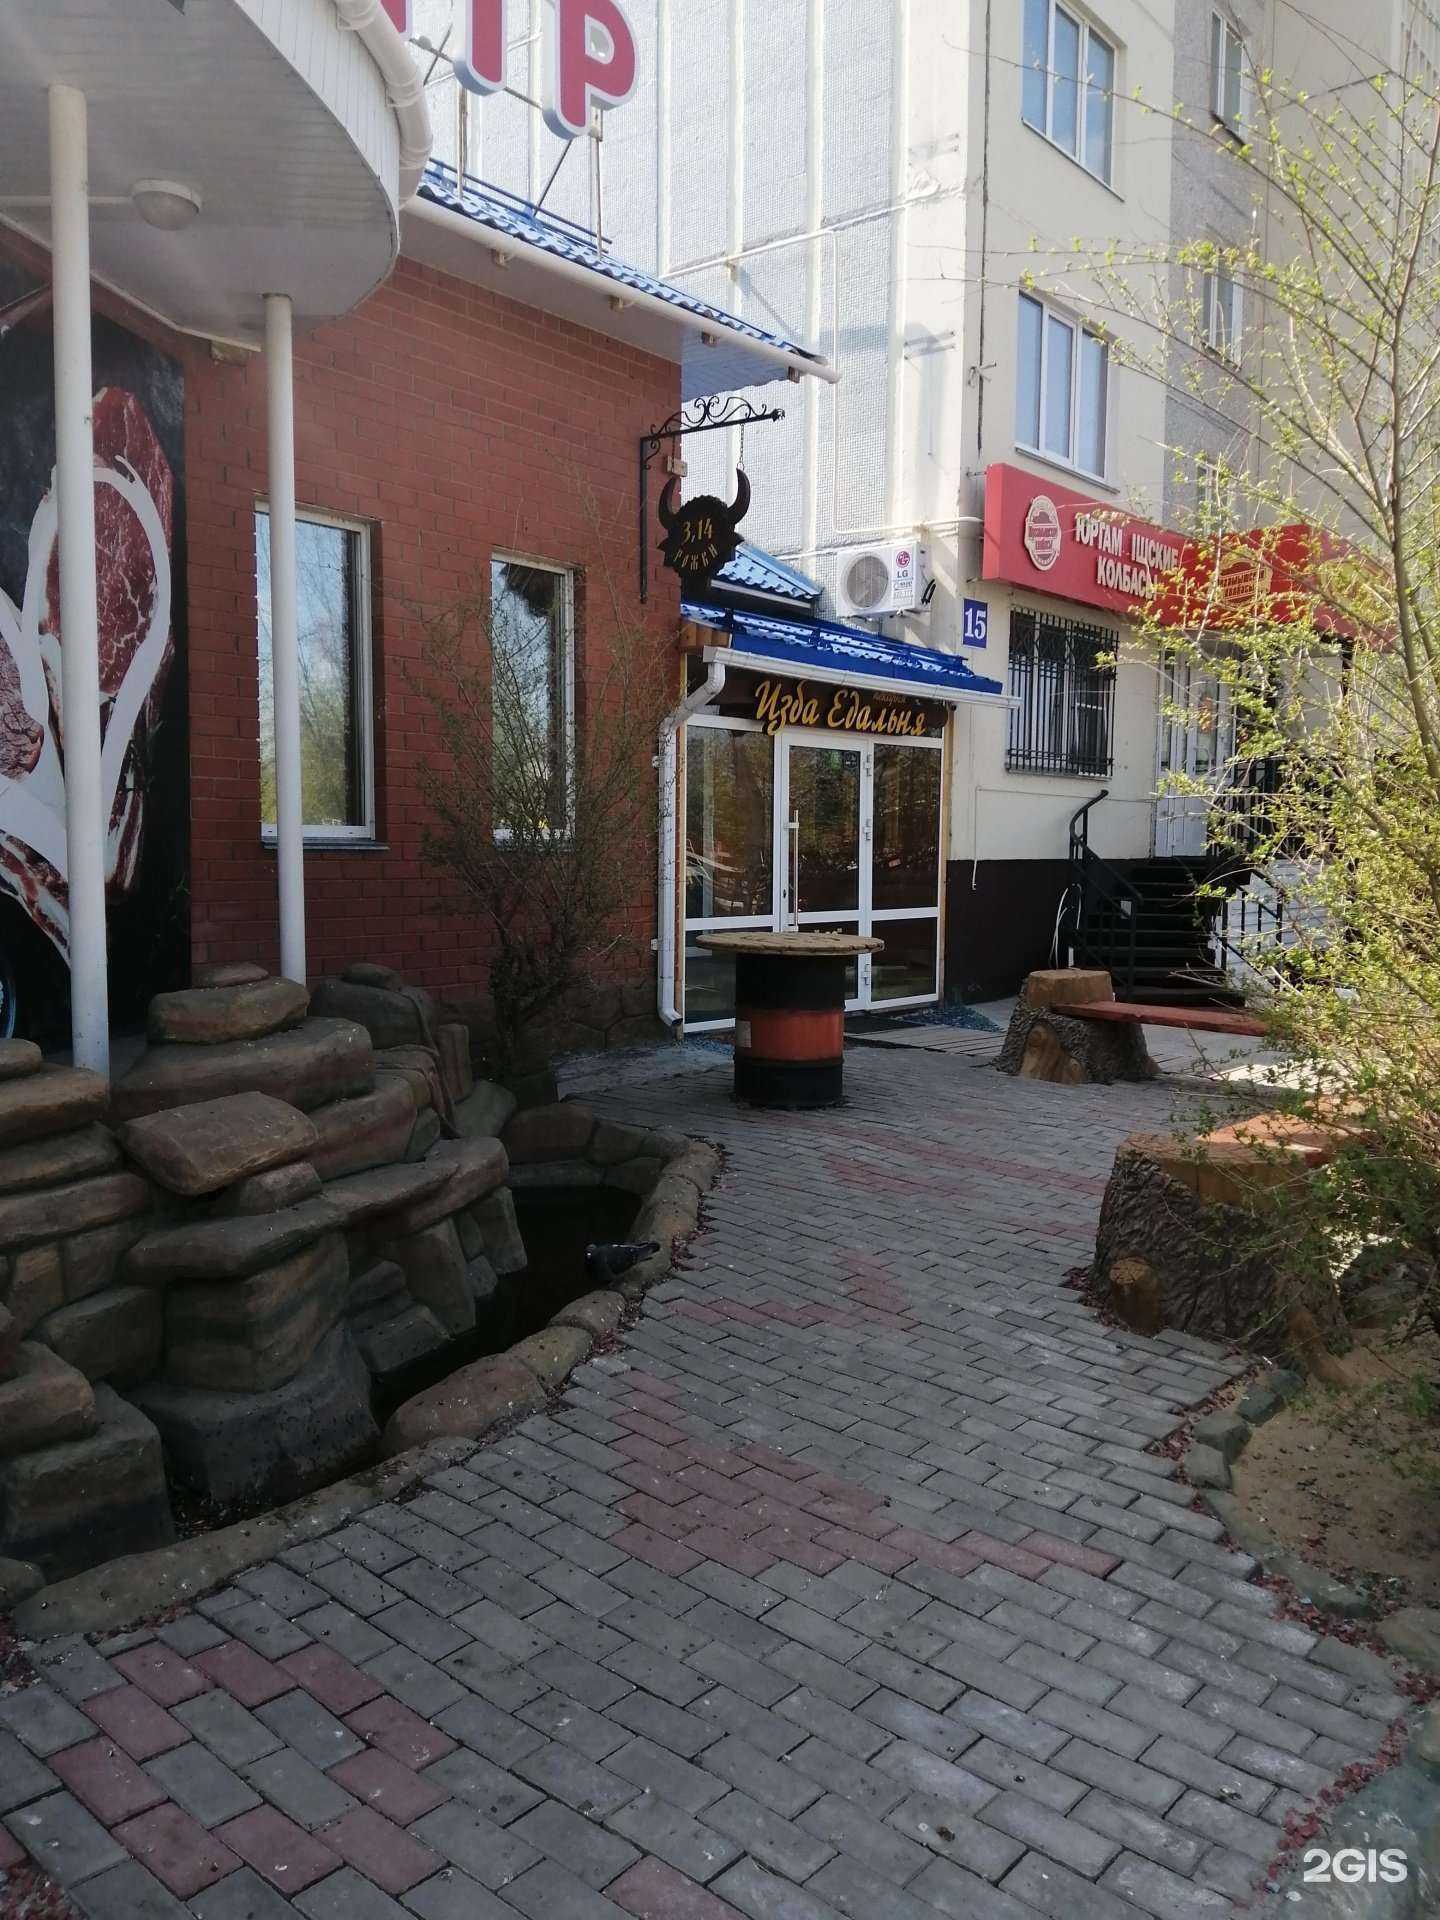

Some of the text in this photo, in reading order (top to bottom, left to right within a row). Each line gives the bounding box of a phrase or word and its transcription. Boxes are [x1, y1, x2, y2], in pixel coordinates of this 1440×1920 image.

[683, 518, 713, 544] 3,14
[897, 569, 909, 579] LG
[964, 607, 987, 640] 15
[755, 678, 928, 737] Изба Едальня
